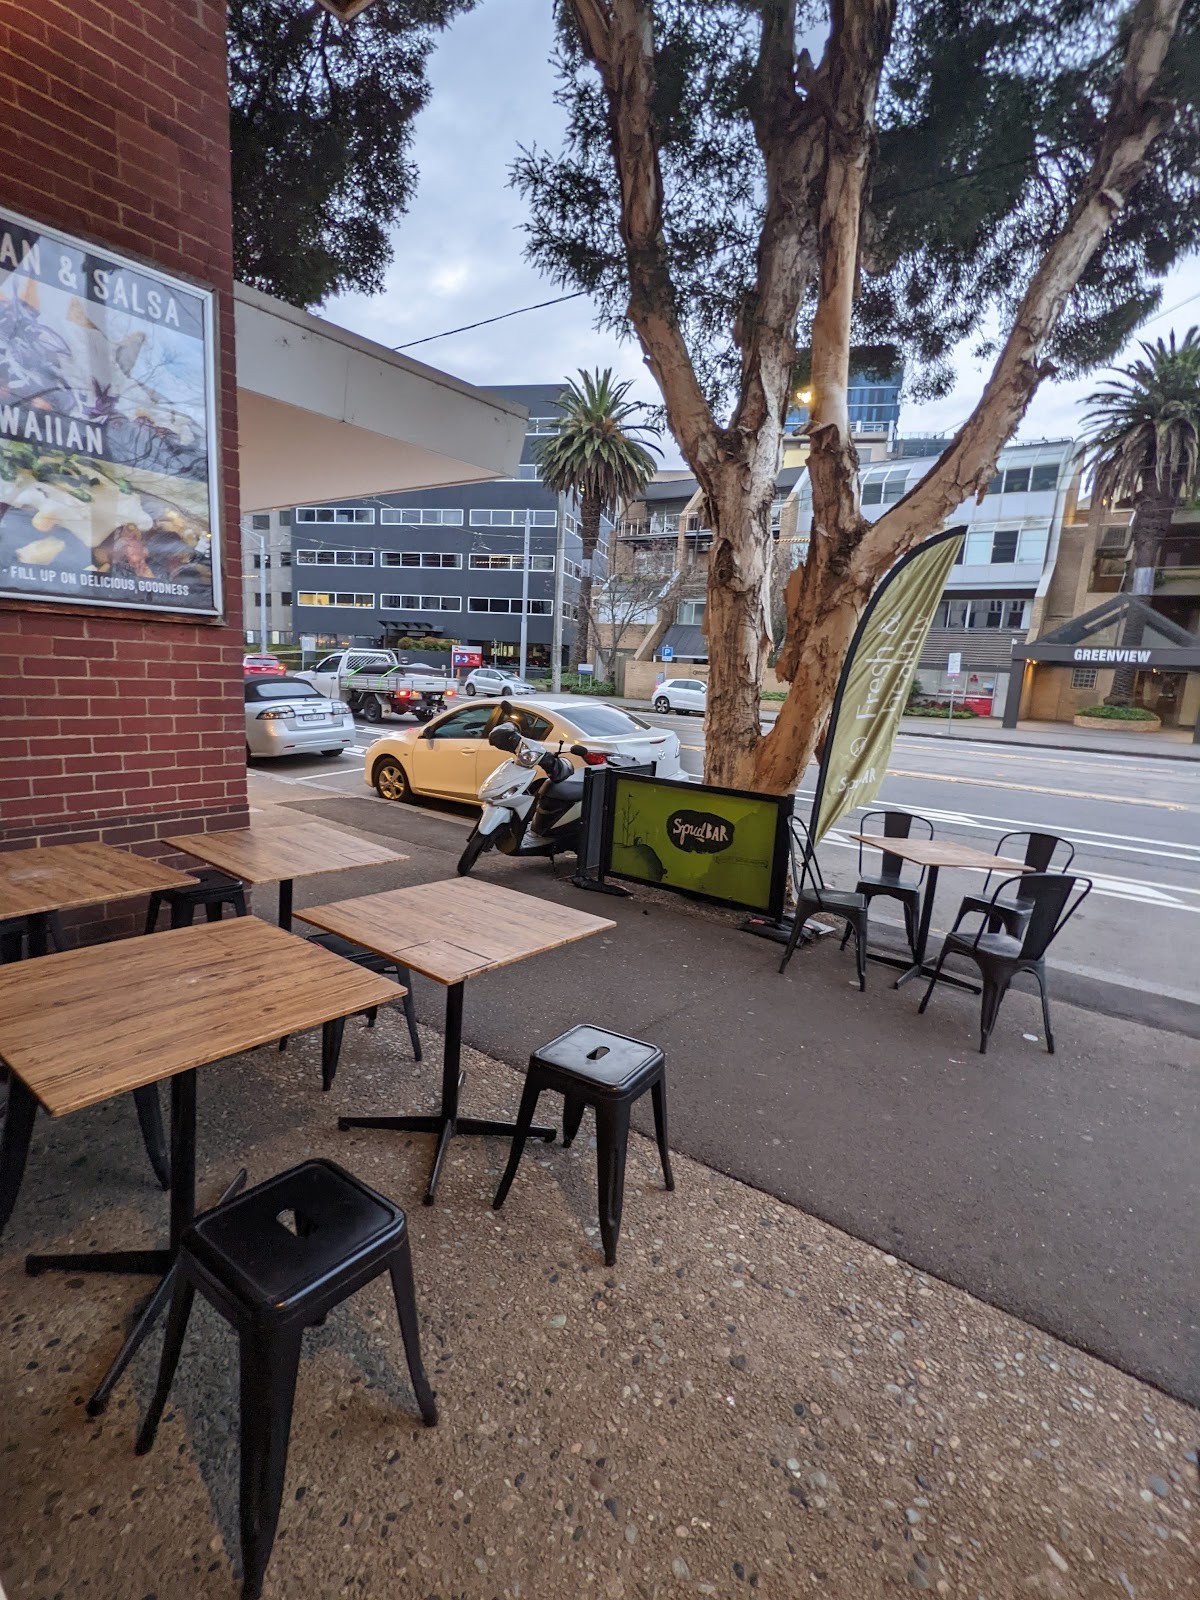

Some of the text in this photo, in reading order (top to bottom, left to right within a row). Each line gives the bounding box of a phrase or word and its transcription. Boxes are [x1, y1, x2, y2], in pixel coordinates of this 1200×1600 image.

[0, 232, 180, 327] AN & SALSA
[0, 404, 103, 455] WAIIAN
[10, 565, 37, 581] FILL
[40, 570, 56, 583] UP
[61, 571, 76, 585] ON
[138, 580, 190, 596] GOODNESS
[856, 611, 902, 720] Fresh &
[1073, 648, 1152, 663] GREENVIEW
